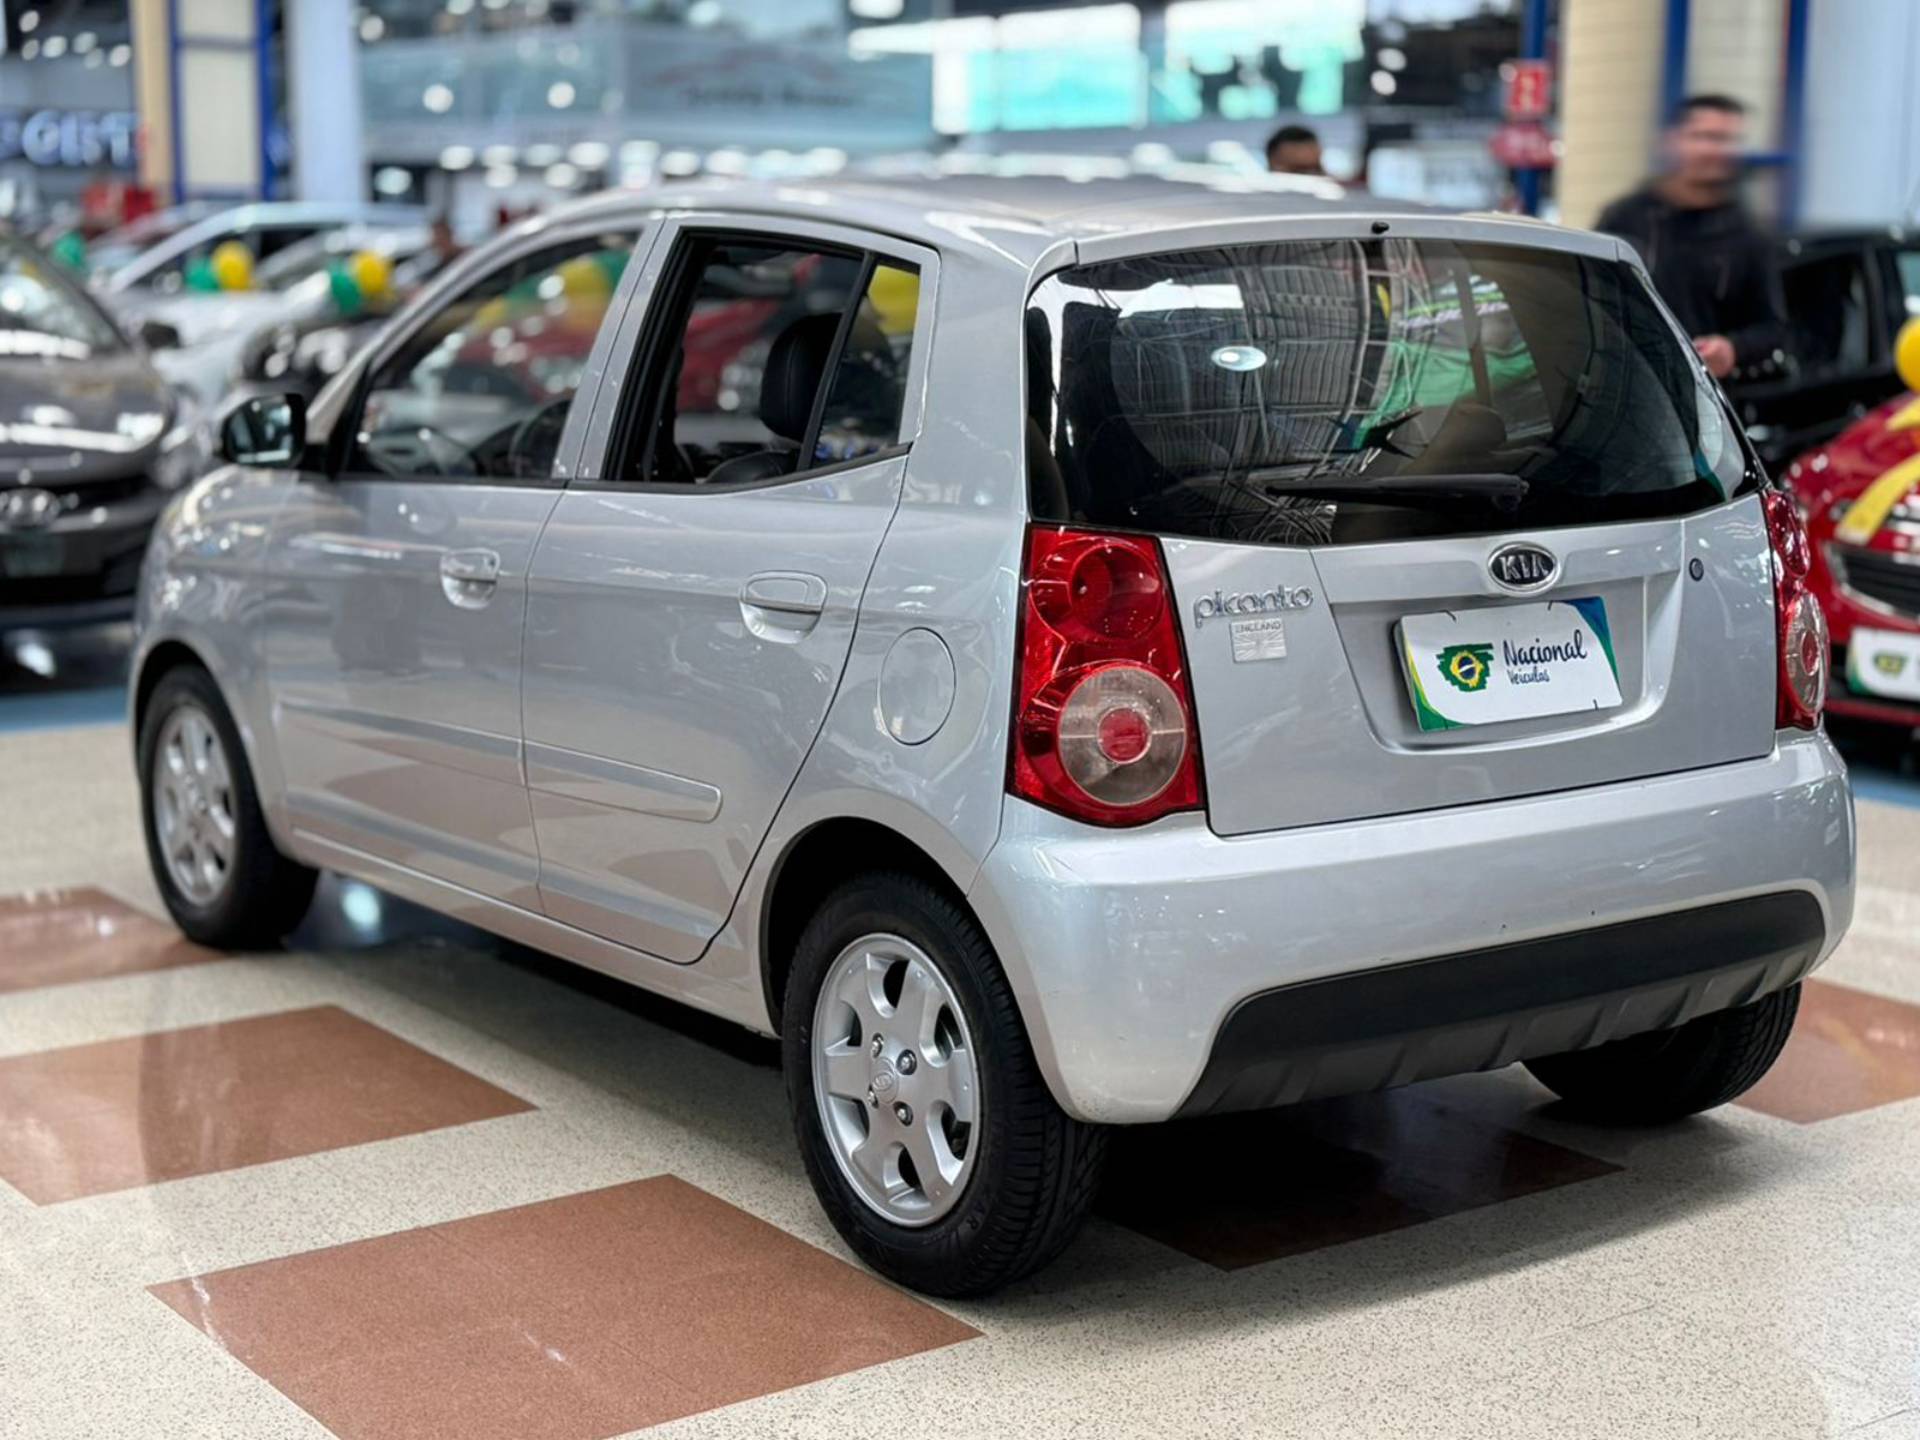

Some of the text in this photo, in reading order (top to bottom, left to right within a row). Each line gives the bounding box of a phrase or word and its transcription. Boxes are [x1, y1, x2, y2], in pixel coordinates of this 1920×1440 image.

[1499, 553, 1549, 581] KIA
[1193, 585, 1314, 629] picanto
[1502, 628, 1588, 667] Nacional
